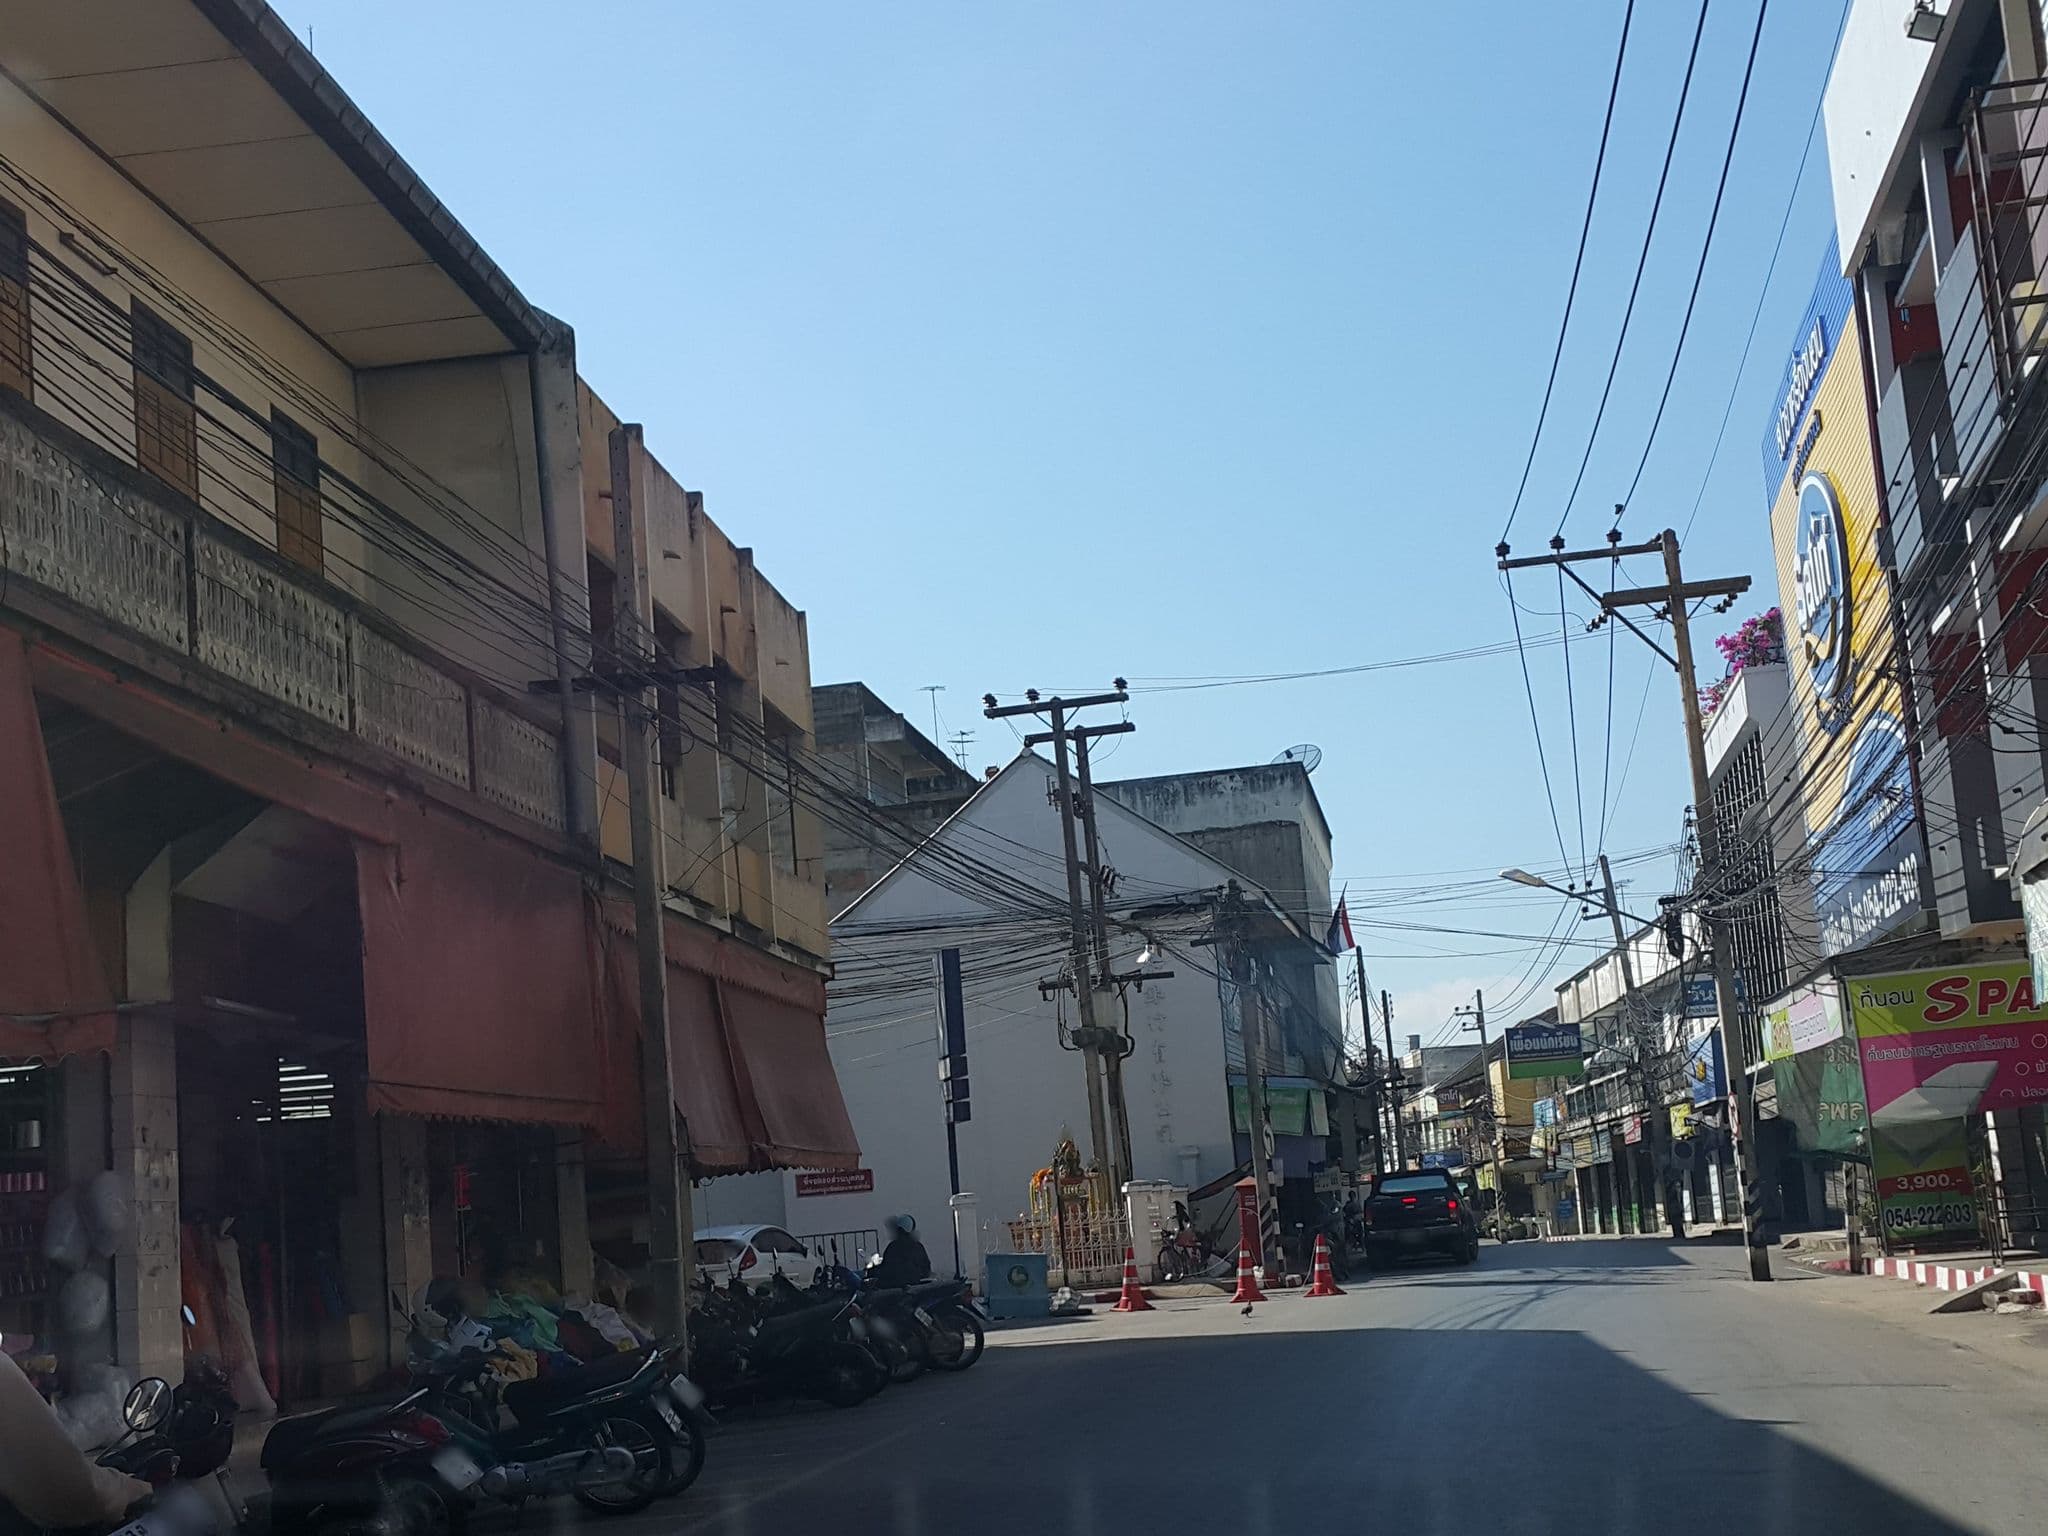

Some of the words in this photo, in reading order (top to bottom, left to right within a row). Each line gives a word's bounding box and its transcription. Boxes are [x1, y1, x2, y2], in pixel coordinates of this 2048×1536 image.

[1860, 985, 1915, 1008] ที่นอน
[1922, 975, 2040, 1023] SPA
[1510, 1030, 1578, 1052] เพื่อนนักเรียน
[1896, 1174, 1963, 1191] 3,900.-
[1885, 1203, 1972, 1228] 054-222603
